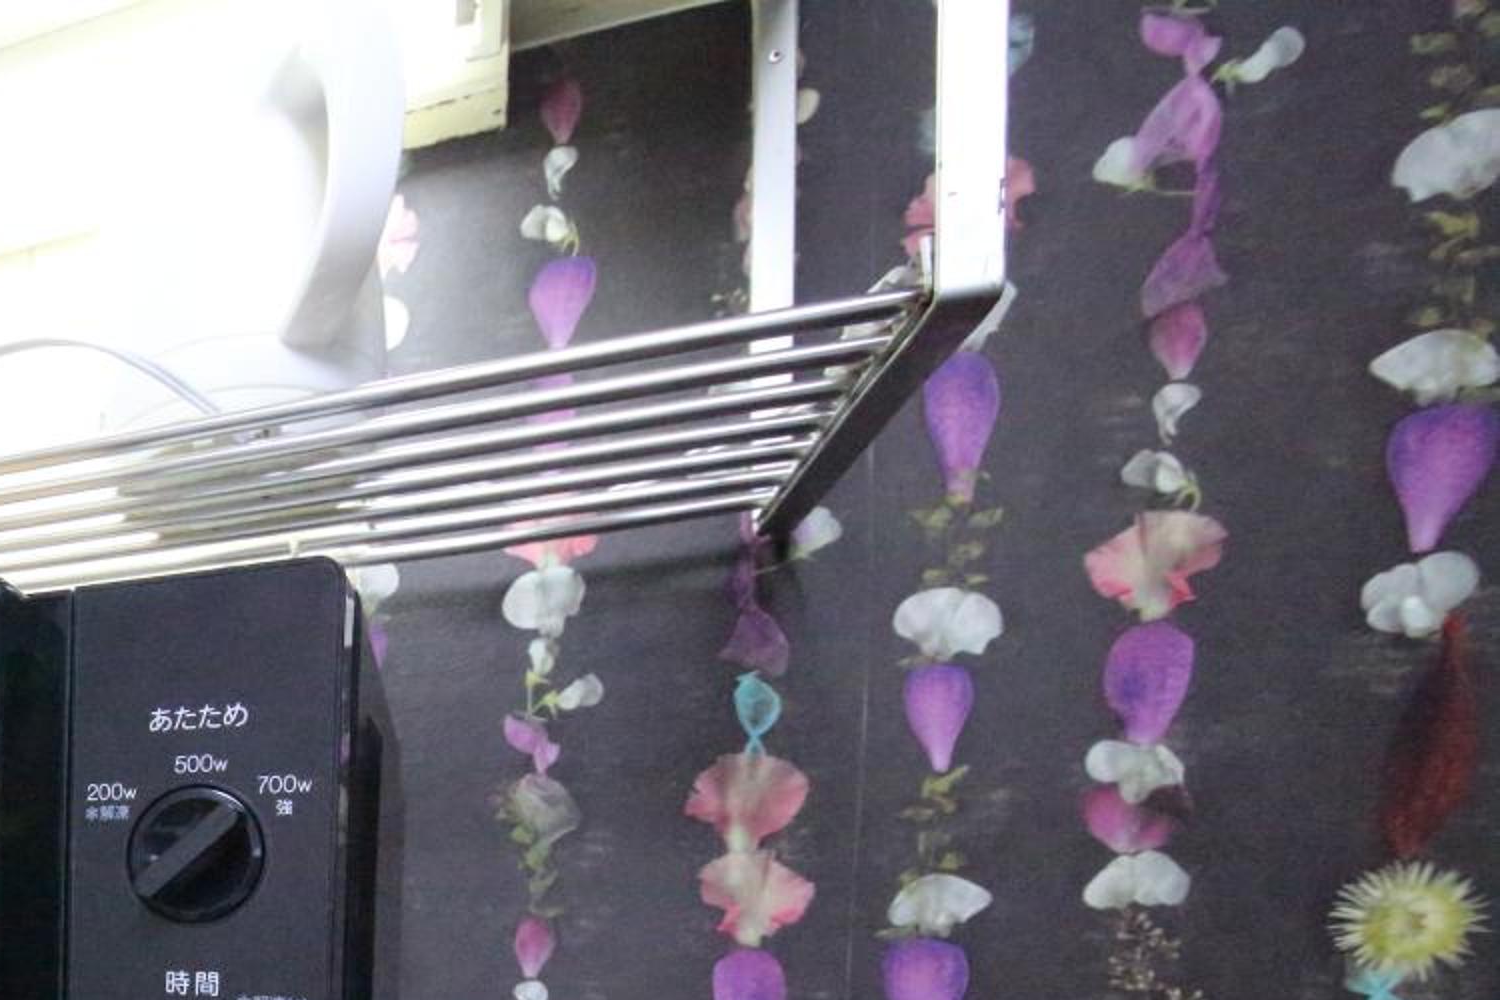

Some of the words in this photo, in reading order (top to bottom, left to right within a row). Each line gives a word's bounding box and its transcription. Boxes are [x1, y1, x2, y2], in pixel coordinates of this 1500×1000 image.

[149, 702, 249, 732] あたため
[276, 800, 293, 816] 強
[165, 971, 220, 997] 時間
